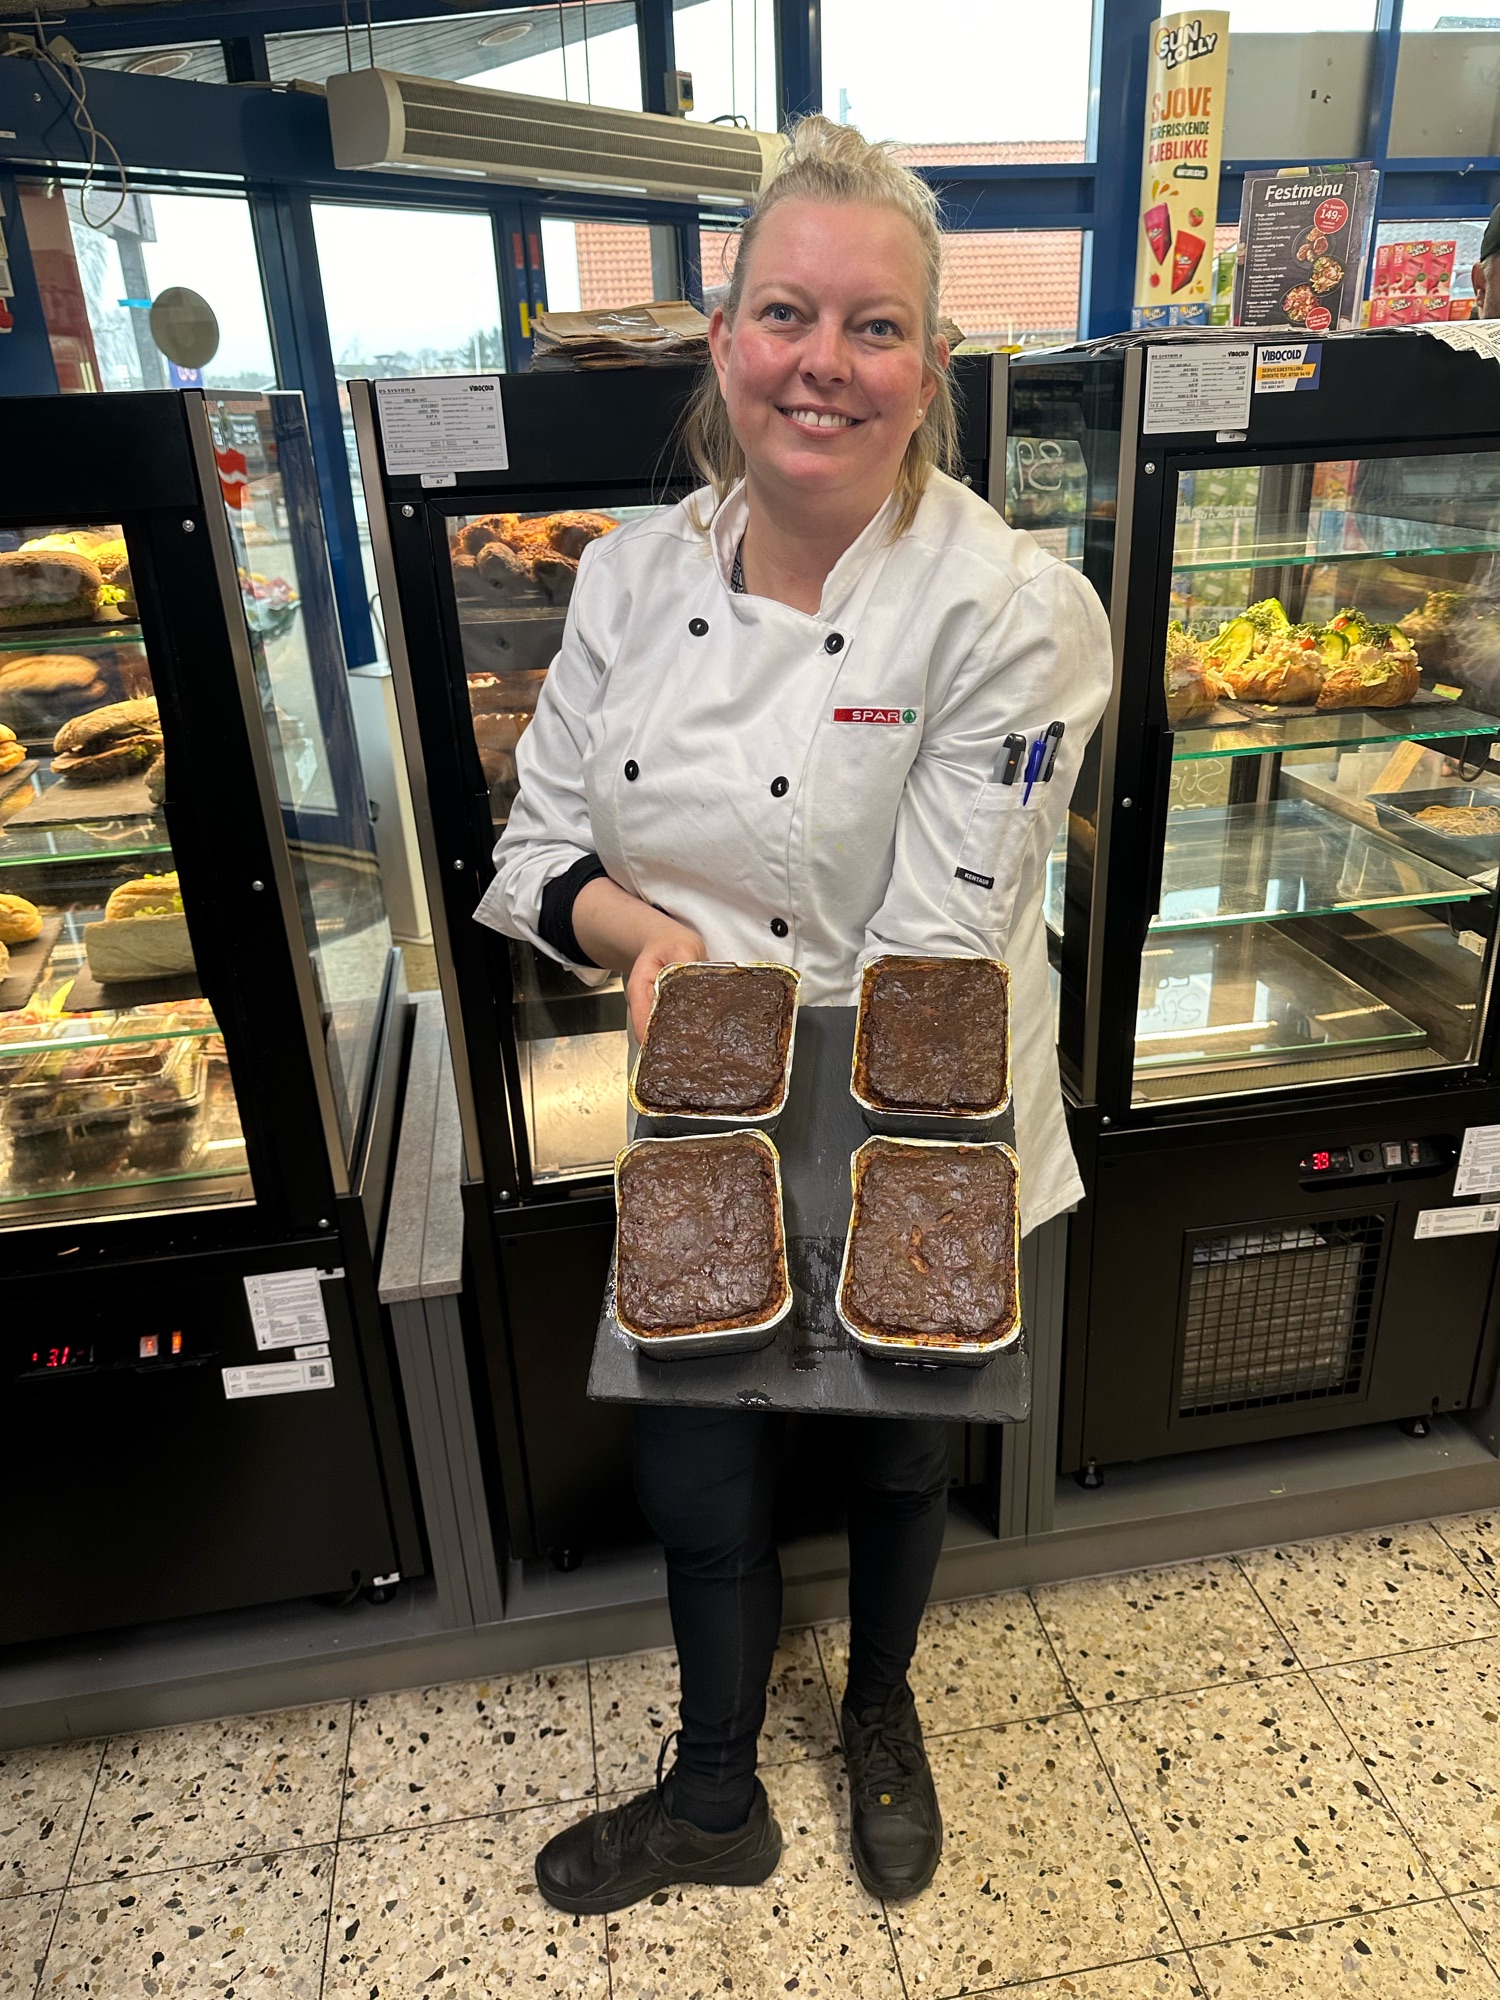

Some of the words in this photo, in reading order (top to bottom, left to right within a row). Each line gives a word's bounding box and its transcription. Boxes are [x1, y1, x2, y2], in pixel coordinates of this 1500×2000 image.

[1159, 20, 1201, 59] SUN
[1166, 33, 1217, 69] LOLLY
[1151, 87, 1212, 123] SJOVE
[1265, 183, 1343, 200] Festmenu
[1262, 349, 1302, 361] VIBOCOLD
[1262, 365, 1303, 373] SERVICEBESTILLING
[469, 384, 494, 392] VIBOCOLD
[852, 710, 899, 722] SPAR
[964, 872, 990, 886] KENTAUR
